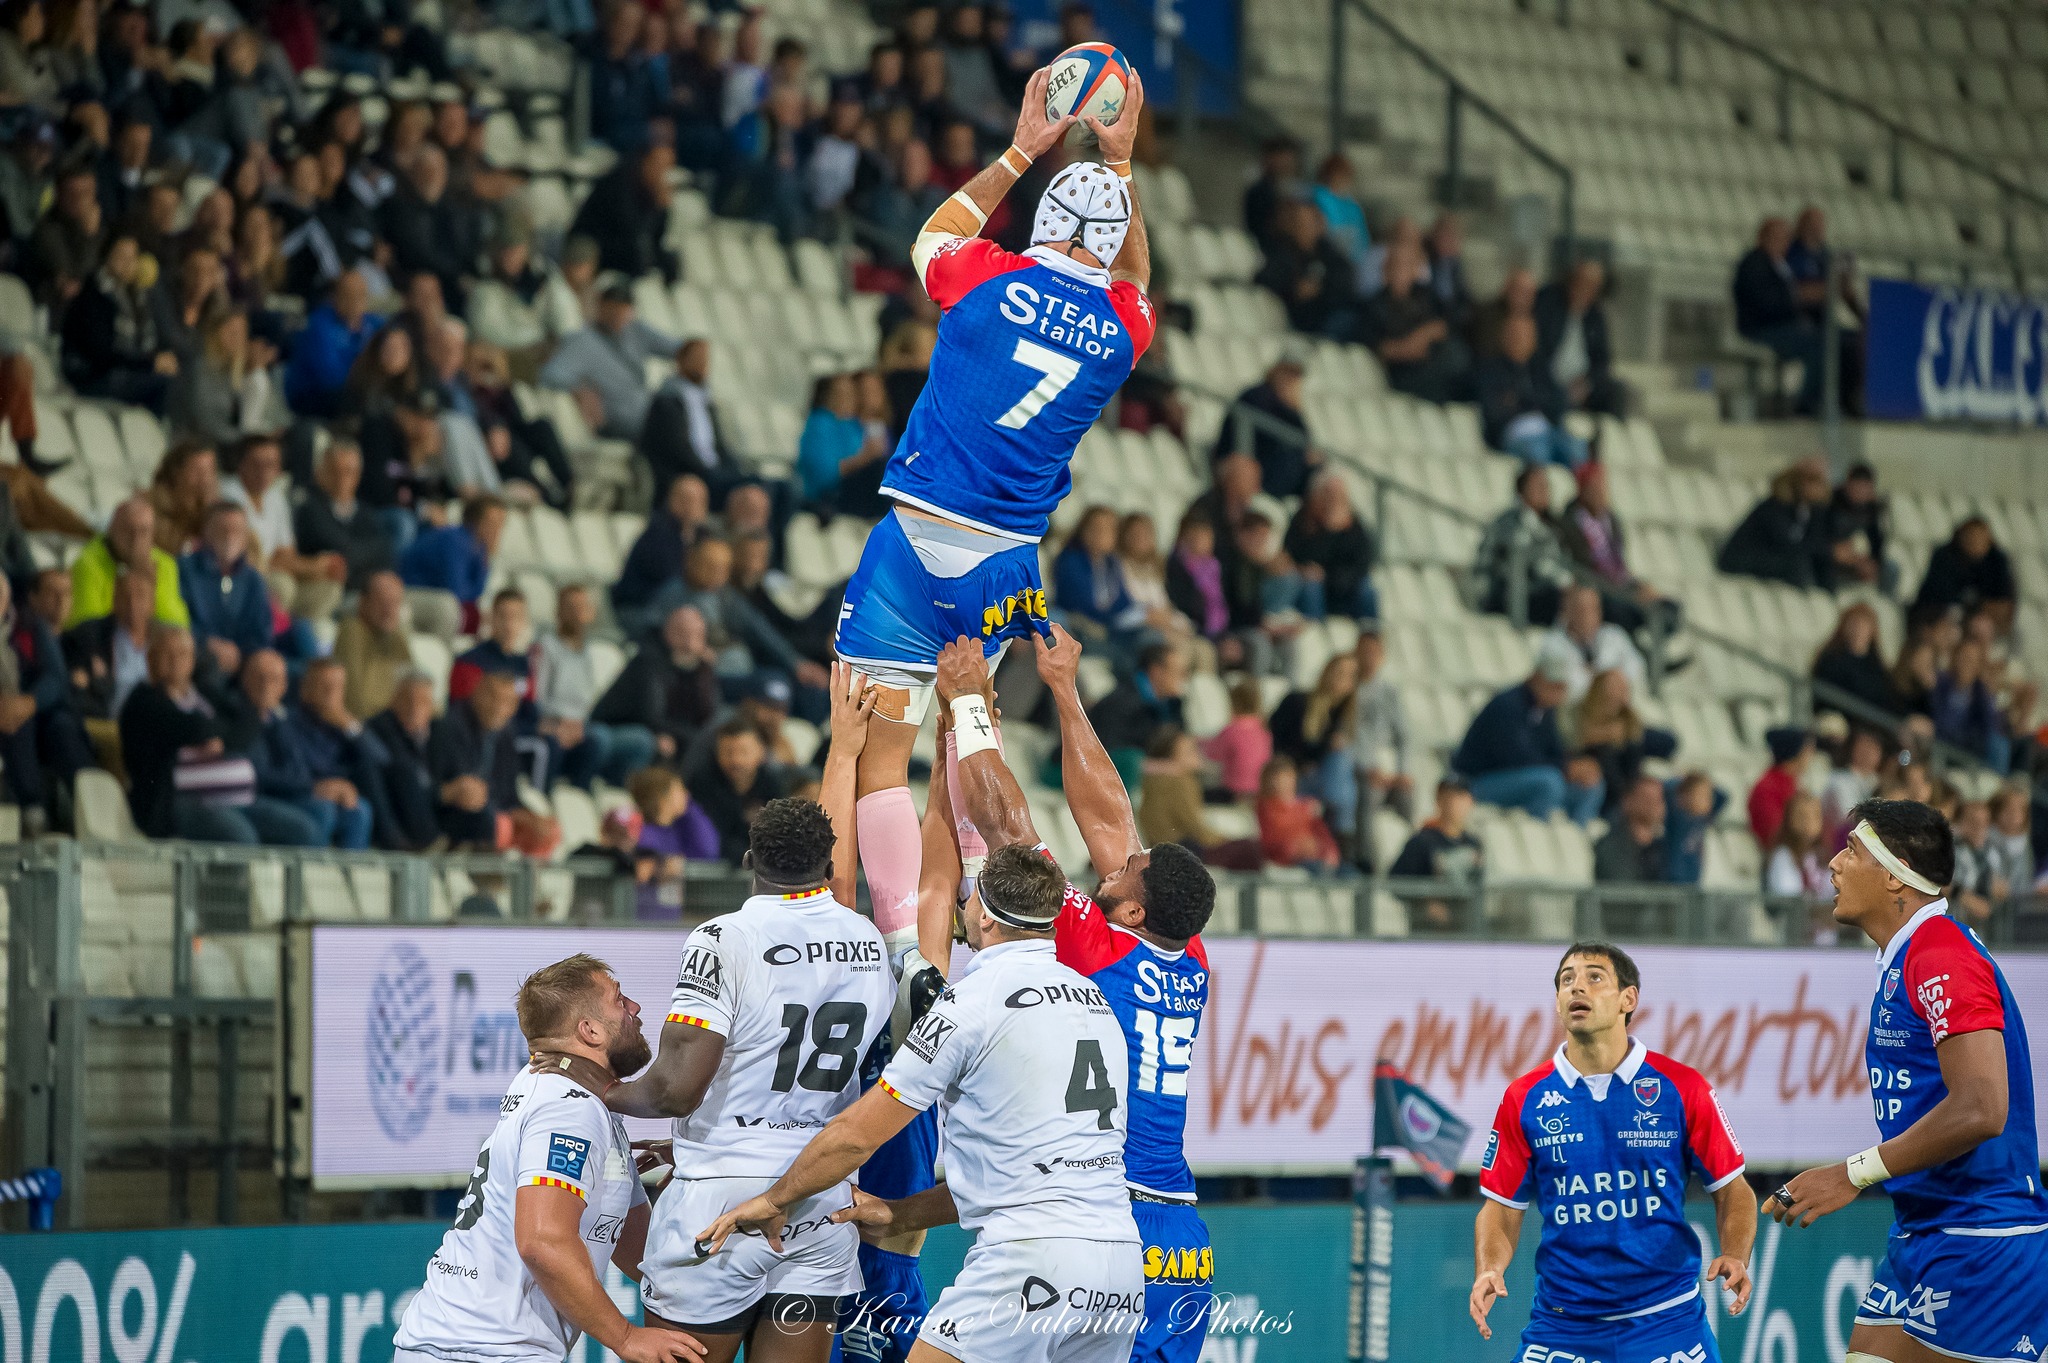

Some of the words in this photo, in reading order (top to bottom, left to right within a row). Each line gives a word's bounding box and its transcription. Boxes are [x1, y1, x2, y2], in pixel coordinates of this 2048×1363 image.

[999, 281, 1119, 340] STEAP
[1040, 318, 1115, 361] tailor
[994, 336, 1084, 430] 7
[683, 948, 723, 986] AIX
[805, 941, 881, 964] praxis
[688, 975, 720, 994] PROVENCE
[1133, 959, 1206, 1004] STEAP
[1162, 992, 1205, 1012] tailor
[770, 1001, 868, 1093] 18
[912, 1014, 954, 1050] AIX
[912, 1035, 938, 1057] PROVENCE
[1204, 940, 1352, 1133] Vous
[1064, 1039, 1119, 1131] 4
[554, 1136, 586, 1153] PRO
[1534, 1132, 1584, 1148] LINKEYS
[1626, 1137, 1671, 1148] MÉTROPOLE
[551, 1153, 581, 1176] D2
[1553, 1168, 1668, 1197] HARDIS
[1553, 1195, 1663, 1226] GROUP
